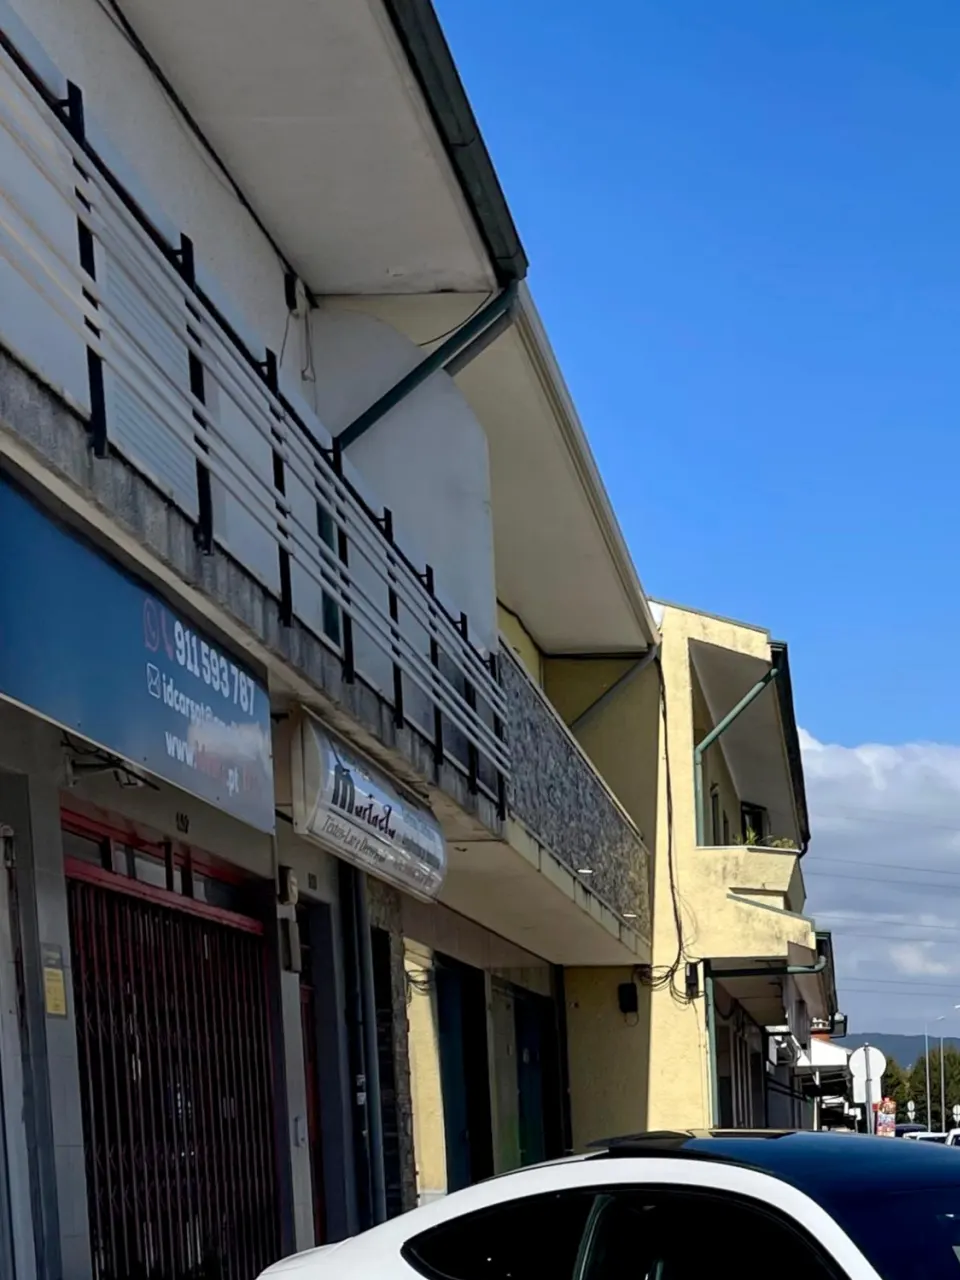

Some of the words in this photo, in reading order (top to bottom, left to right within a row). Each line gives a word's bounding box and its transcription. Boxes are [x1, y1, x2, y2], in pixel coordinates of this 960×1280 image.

[175, 620, 200, 678] 911
[201, 640, 229, 698] 593
[230, 663, 255, 716] 787
